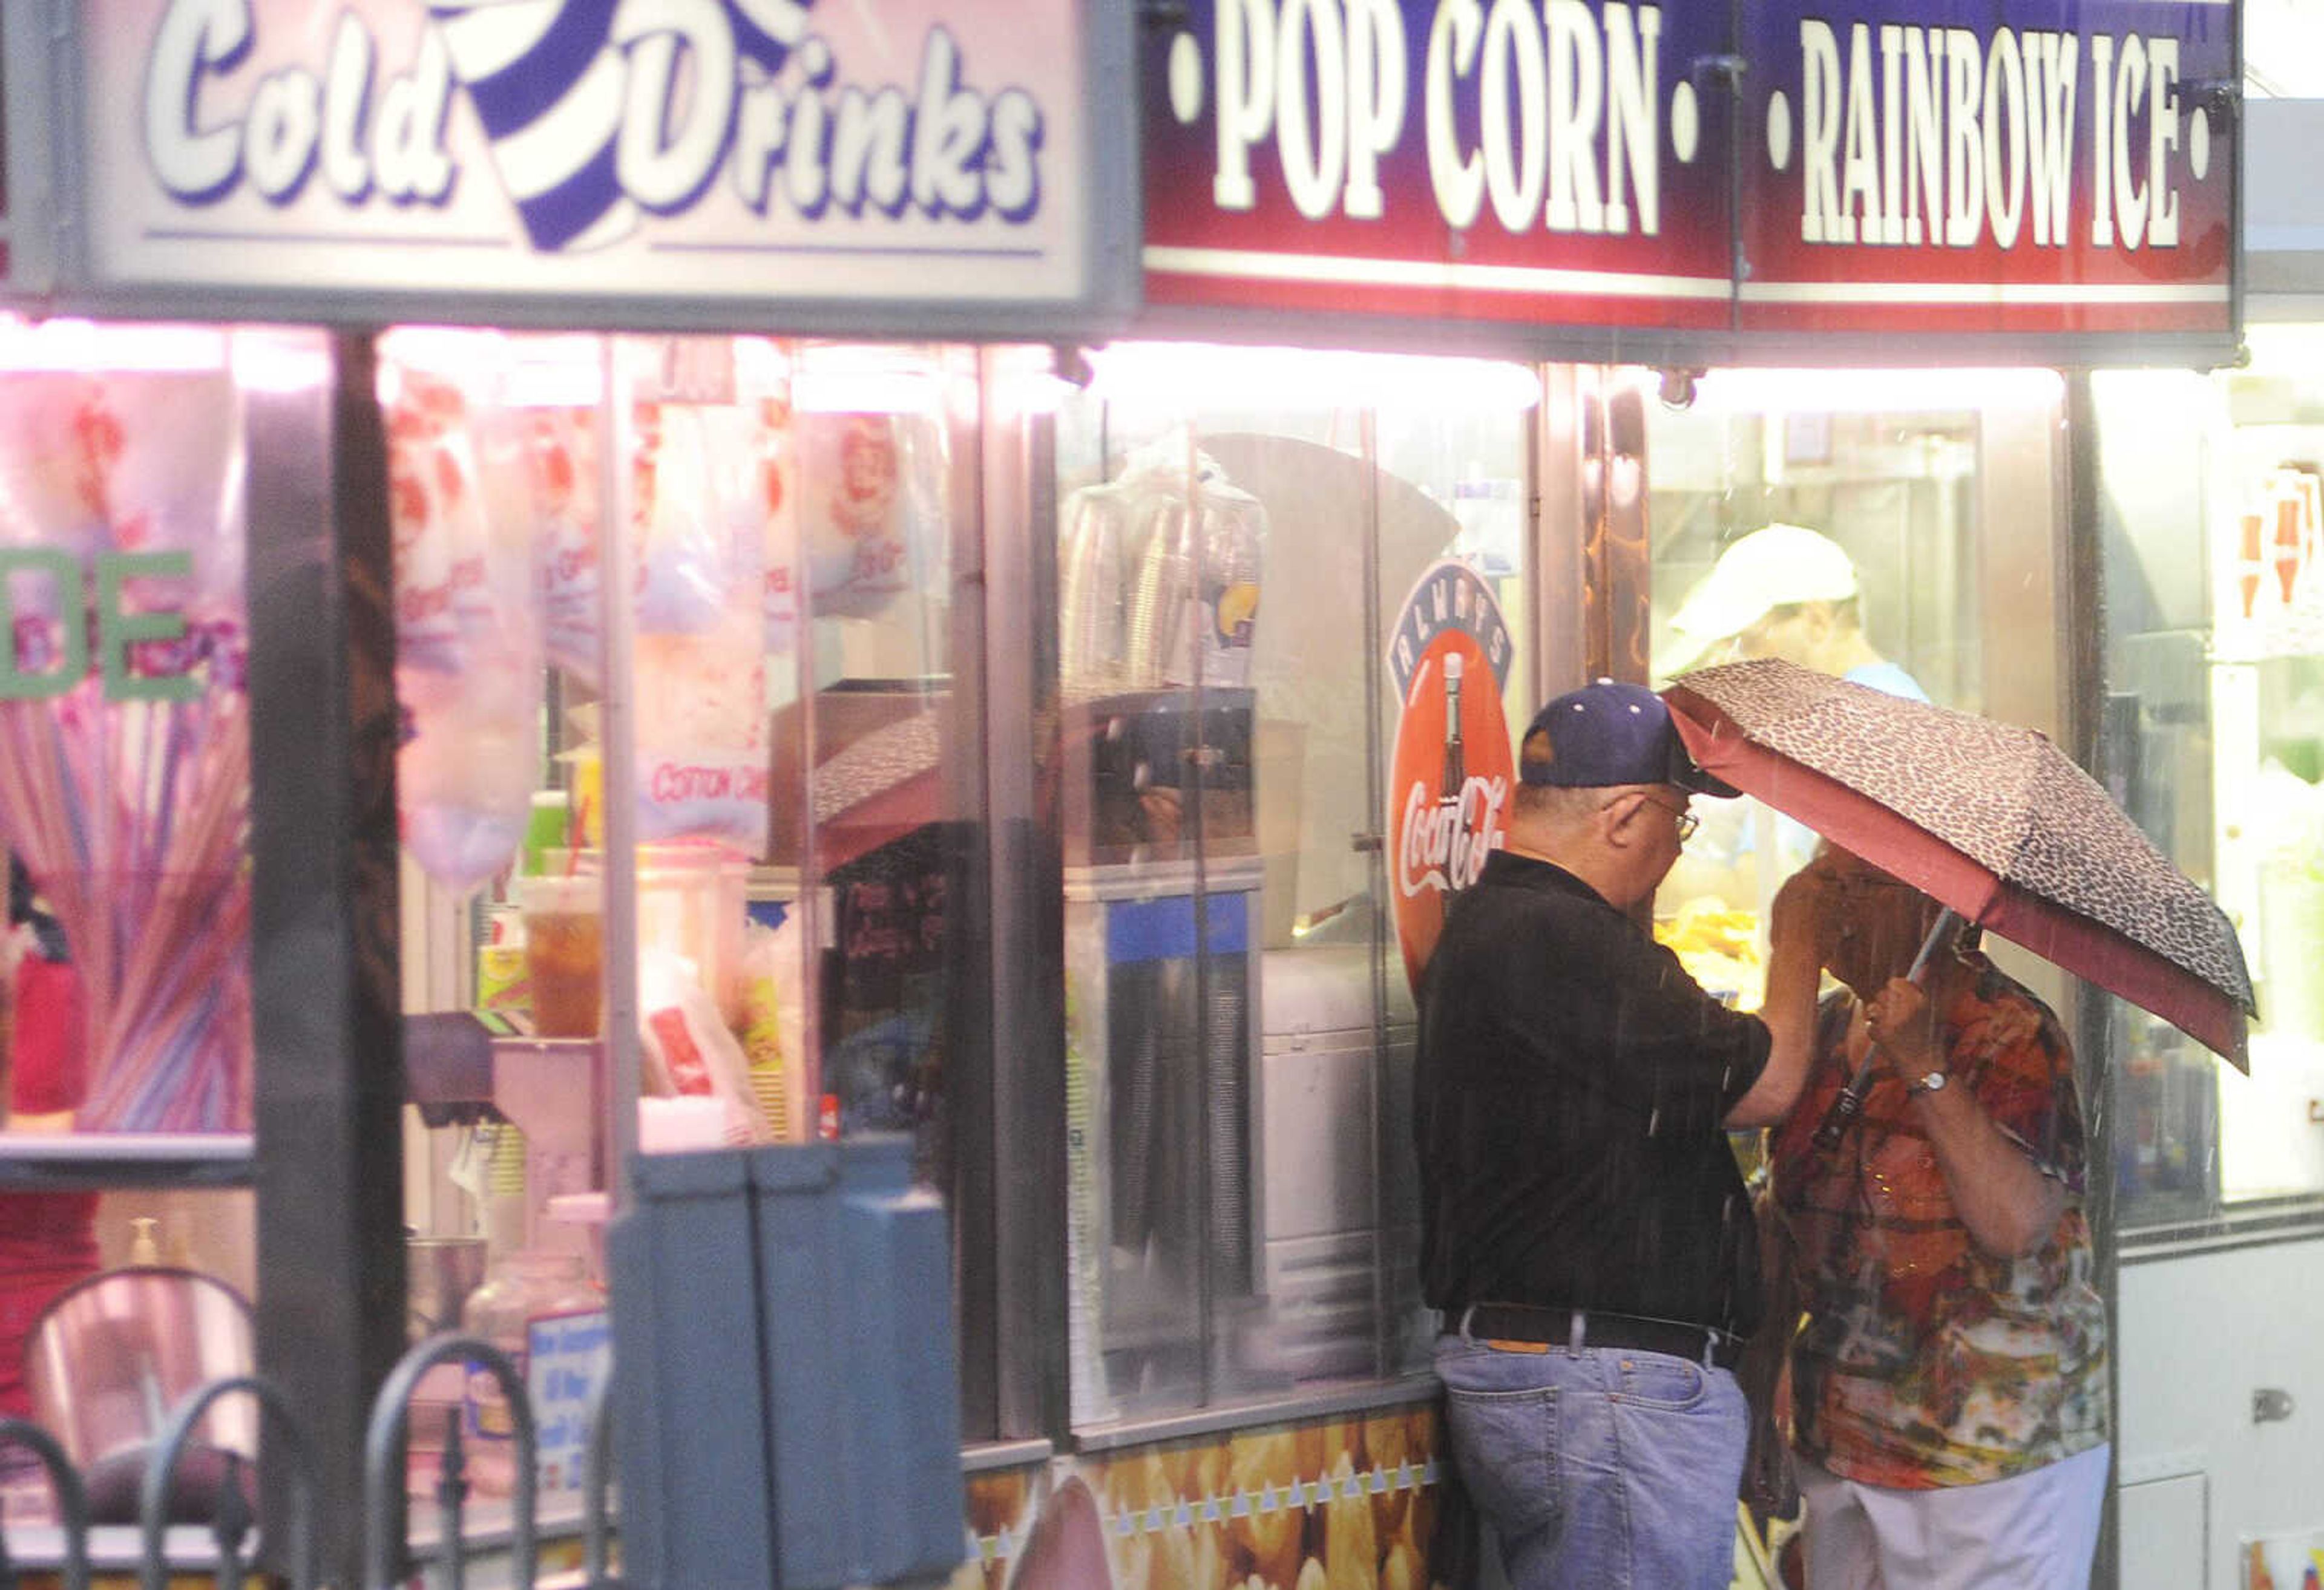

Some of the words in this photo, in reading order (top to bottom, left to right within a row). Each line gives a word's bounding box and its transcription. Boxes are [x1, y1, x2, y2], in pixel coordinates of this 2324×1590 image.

[145, 0, 461, 207] Cold
[615, 0, 1045, 224] Drinks
[1213, 0, 1408, 220] POP
[1425, 0, 1661, 235] CORN
[1800, 19, 2079, 249] RAINBOW
[2091, 33, 2179, 250] ICE
[1397, 578, 1506, 677] ALWAYS
